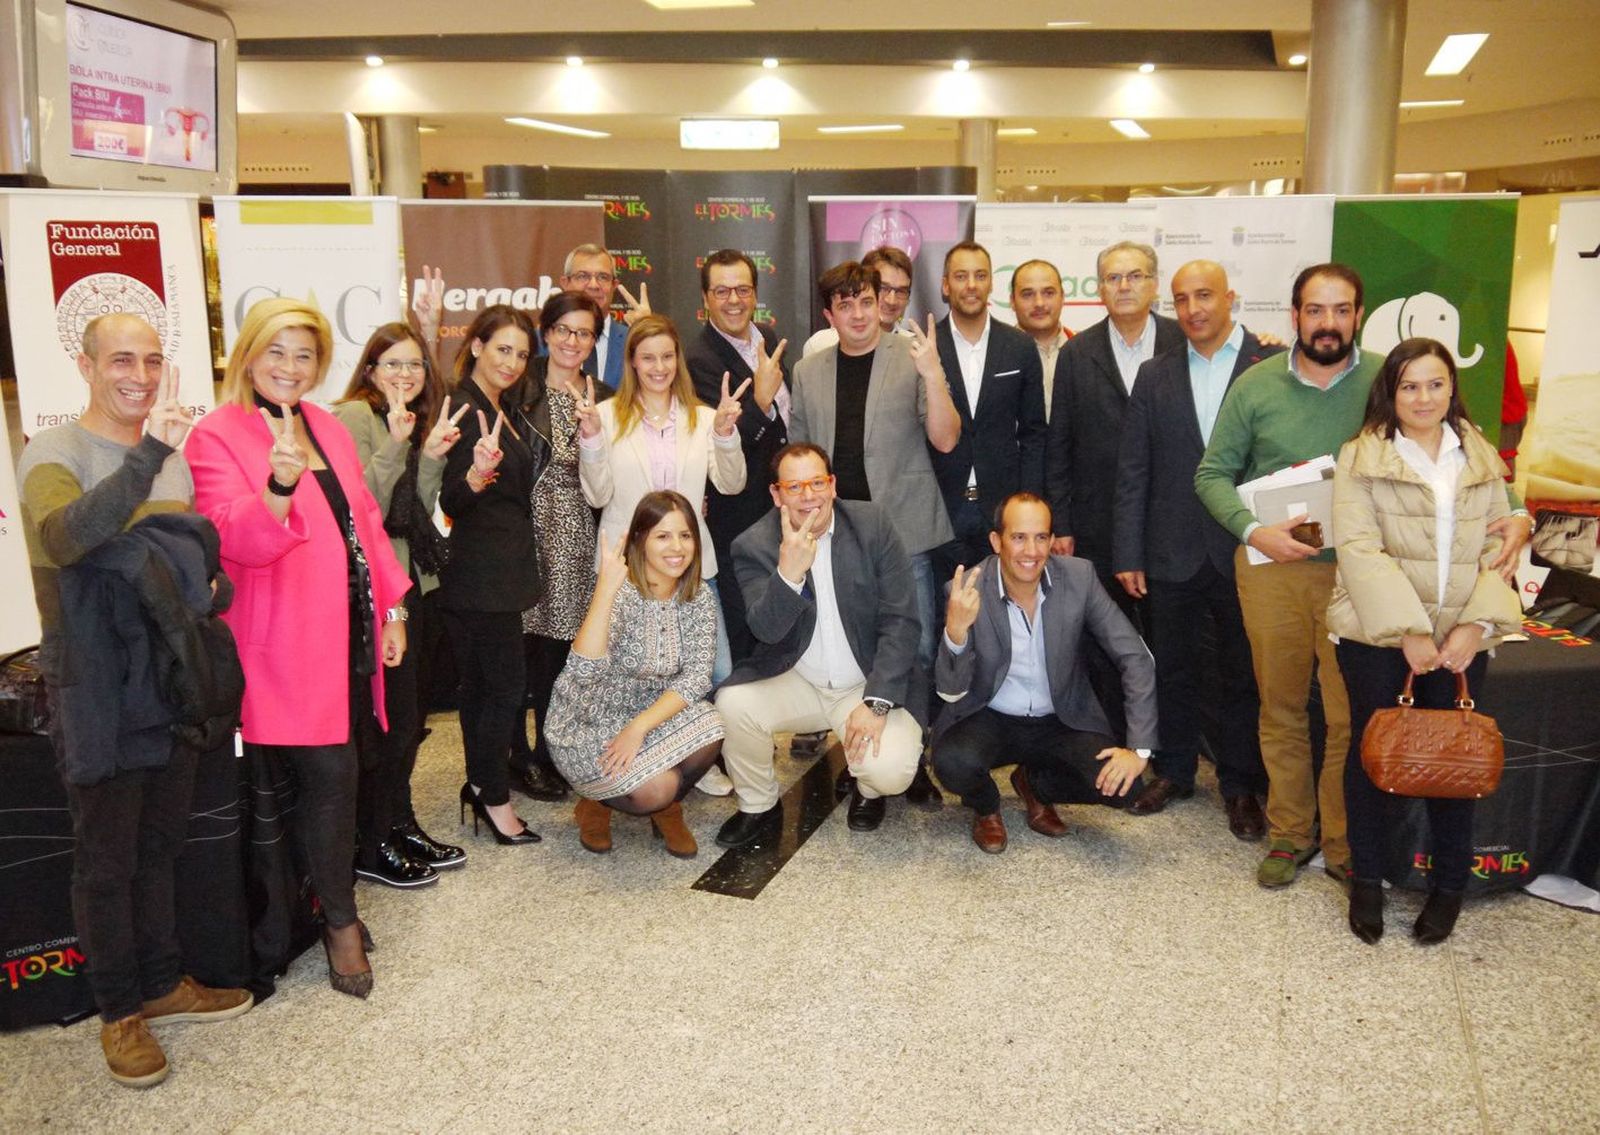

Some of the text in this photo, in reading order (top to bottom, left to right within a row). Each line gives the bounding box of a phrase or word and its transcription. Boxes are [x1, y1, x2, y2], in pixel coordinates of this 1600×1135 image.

[69, 64, 93, 79] BOLA
[95, 70, 119, 84] INTRA
[120, 75, 154, 91] UTERINA
[603, 200, 652, 220] RMES
[51, 223, 157, 241] Fundación
[51, 242, 121, 256] General
[1470, 850, 1530, 879] RMES
[6, 943, 42, 958] CENTRO
